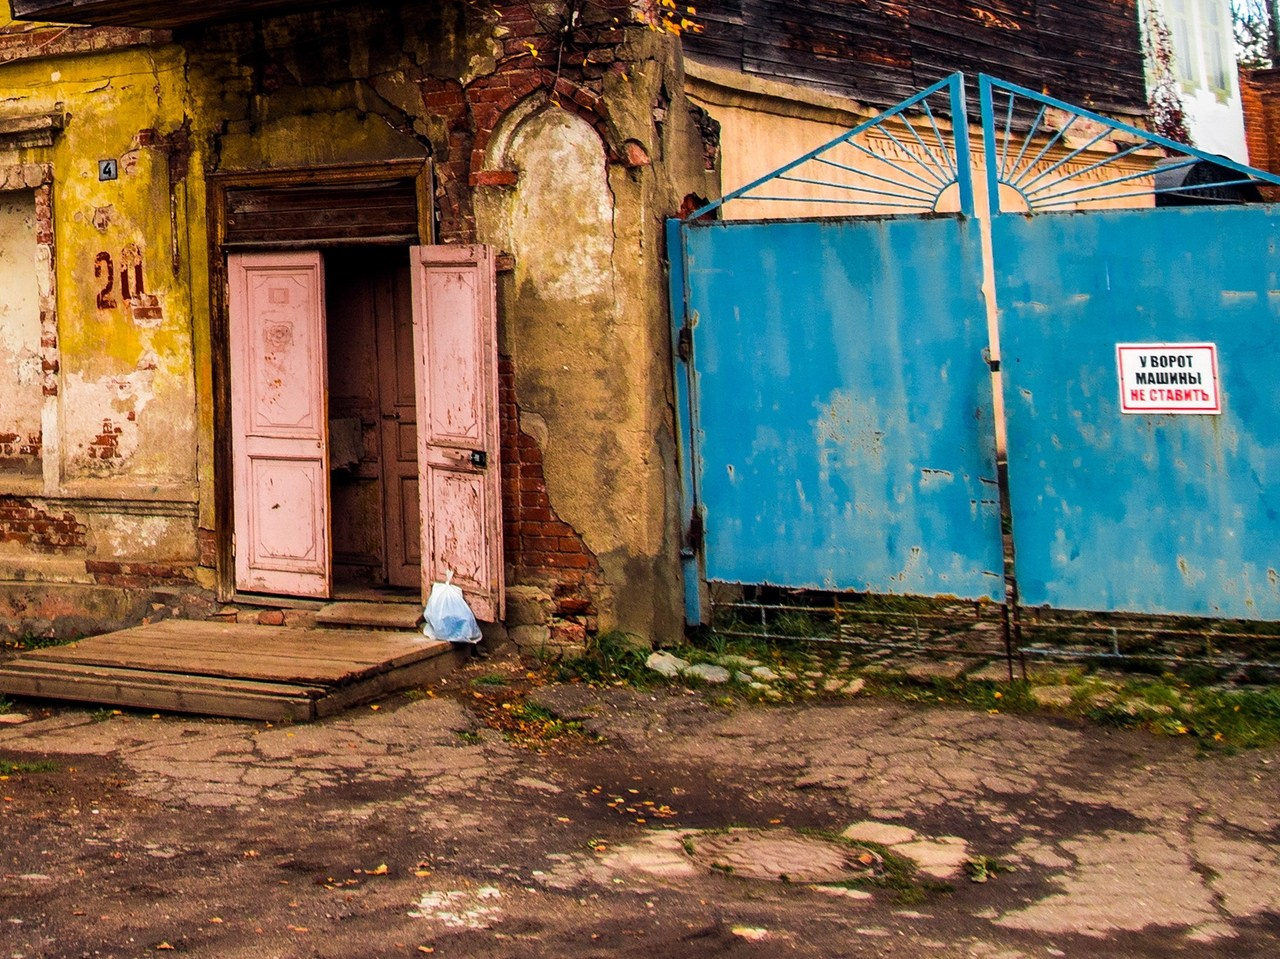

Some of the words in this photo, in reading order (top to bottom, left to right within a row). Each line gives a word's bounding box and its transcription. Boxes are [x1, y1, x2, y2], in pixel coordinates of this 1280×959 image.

[102, 162, 113, 177] 4
[1139, 355, 1147, 368] У
[1150, 355, 1193, 368] ВОРОТ
[1135, 372, 1202, 385] МАШИНЫ
[1130, 389, 1146, 401] НЕ
[1149, 389, 1210, 401] СТАВИТЬ
